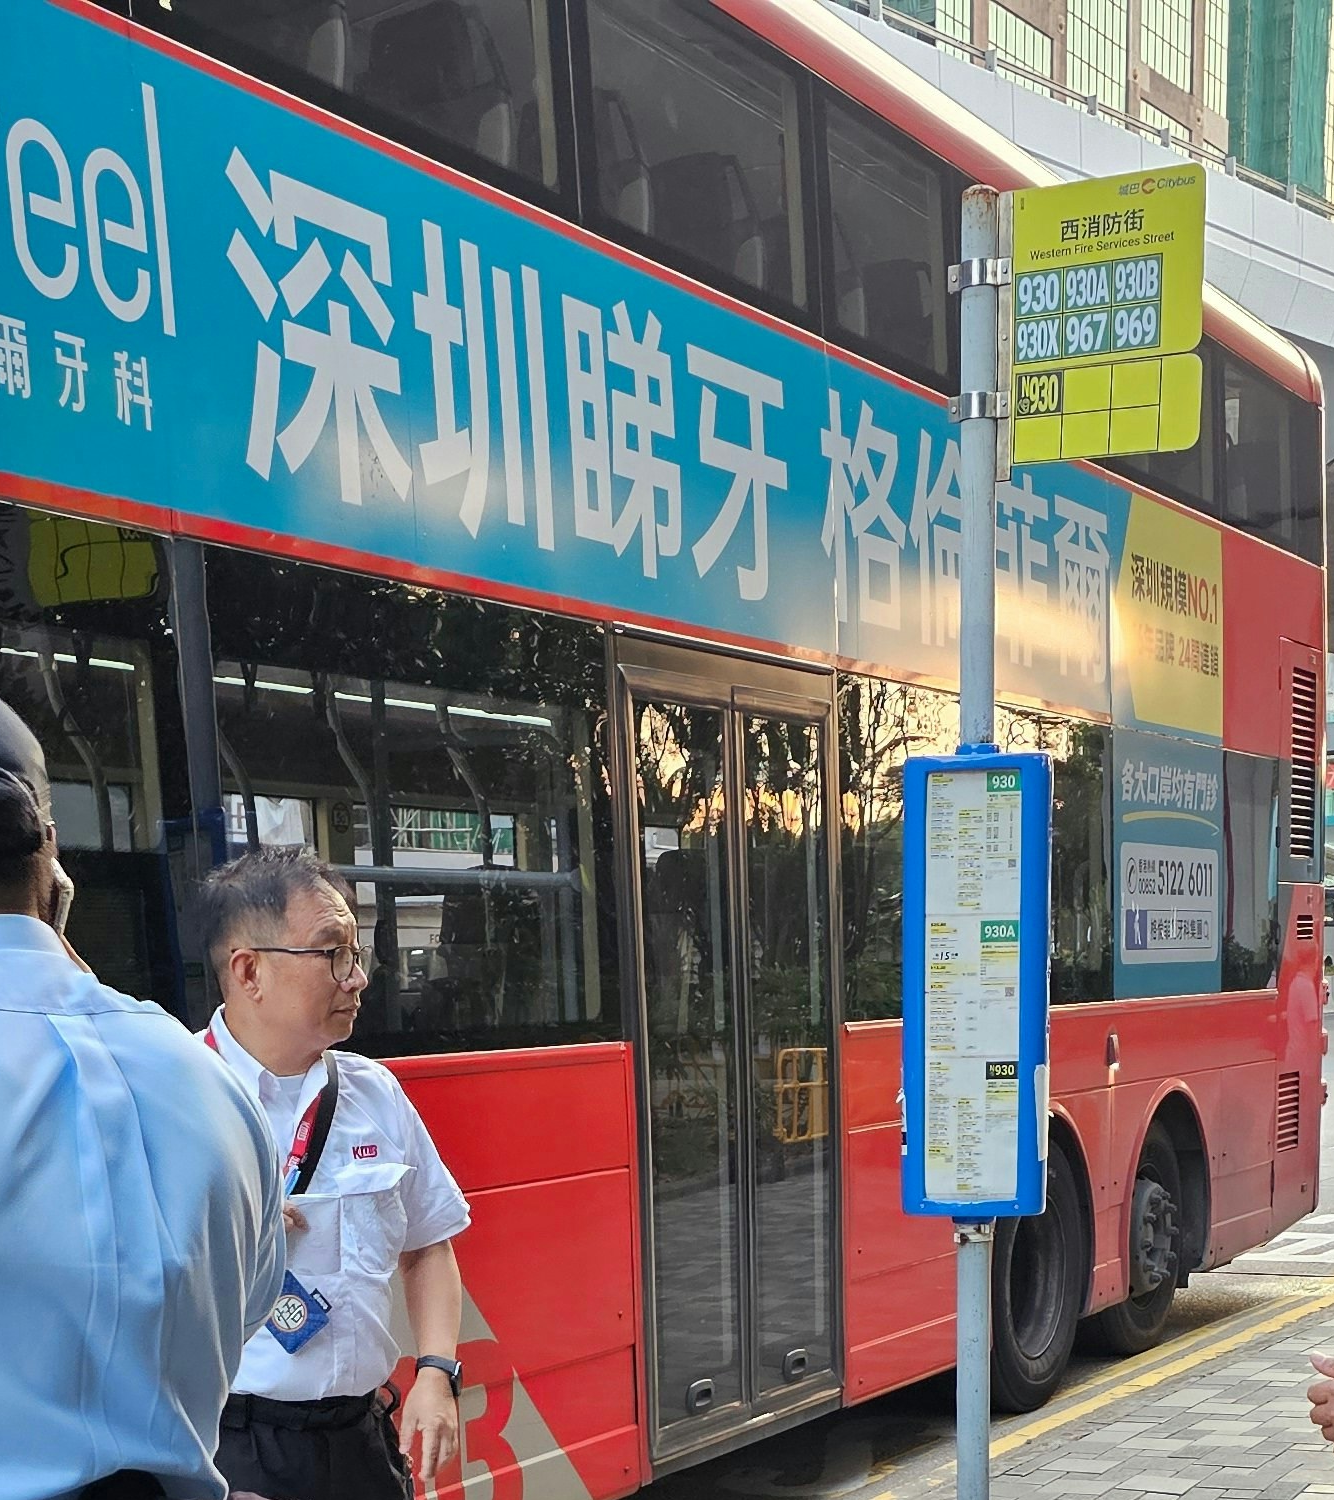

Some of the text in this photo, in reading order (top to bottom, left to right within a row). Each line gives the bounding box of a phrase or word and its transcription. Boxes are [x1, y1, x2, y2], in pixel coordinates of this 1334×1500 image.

[1119, 175, 1196, 197] 城巴 Citybus
[1060, 208, 1145, 242] 西消防街
[1030, 231, 1175, 260] Western Fire Services Street
[1018, 259, 1160, 314] 930 930A 930B
[1017, 306, 1157, 361] 930X 967 969
[225, 146, 788, 601] 深圳睇牙
[1021, 373, 1059, 414] N930
[992, 774, 1016, 789] 930
[1121, 758, 1218, 812] 各大口岸均有門診
[1158, 860, 1184, 895] 5122
[1189, 862, 1213, 897] 6011
[985, 924, 1016, 938] 930A
[989, 1064, 1015, 1076] N930
[352, 1145, 378, 1159] KMB
